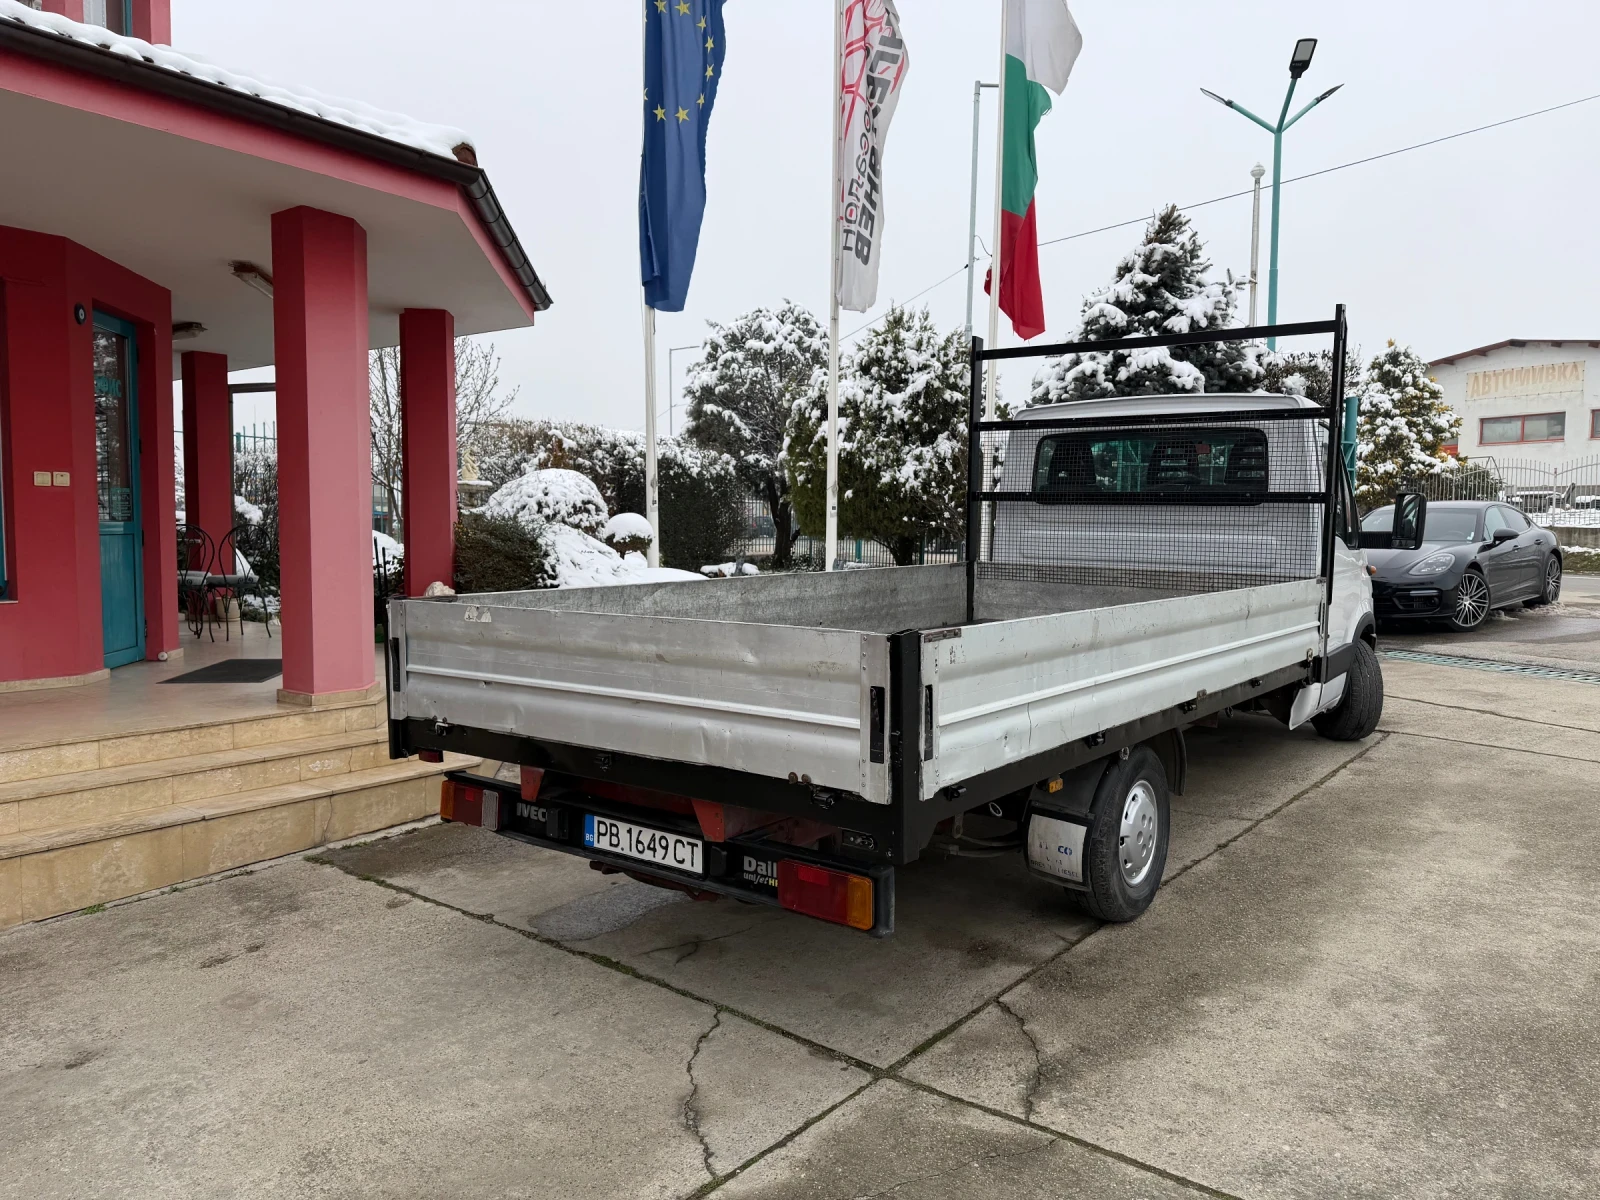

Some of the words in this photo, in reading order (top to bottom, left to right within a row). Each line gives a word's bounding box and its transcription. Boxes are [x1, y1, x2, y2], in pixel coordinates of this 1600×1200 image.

[1470, 363, 1580, 398] АВТОМИВКА
[517, 802, 547, 823] IVEC
[585, 833, 594, 842] BG
[743, 855, 778, 878] Dail
